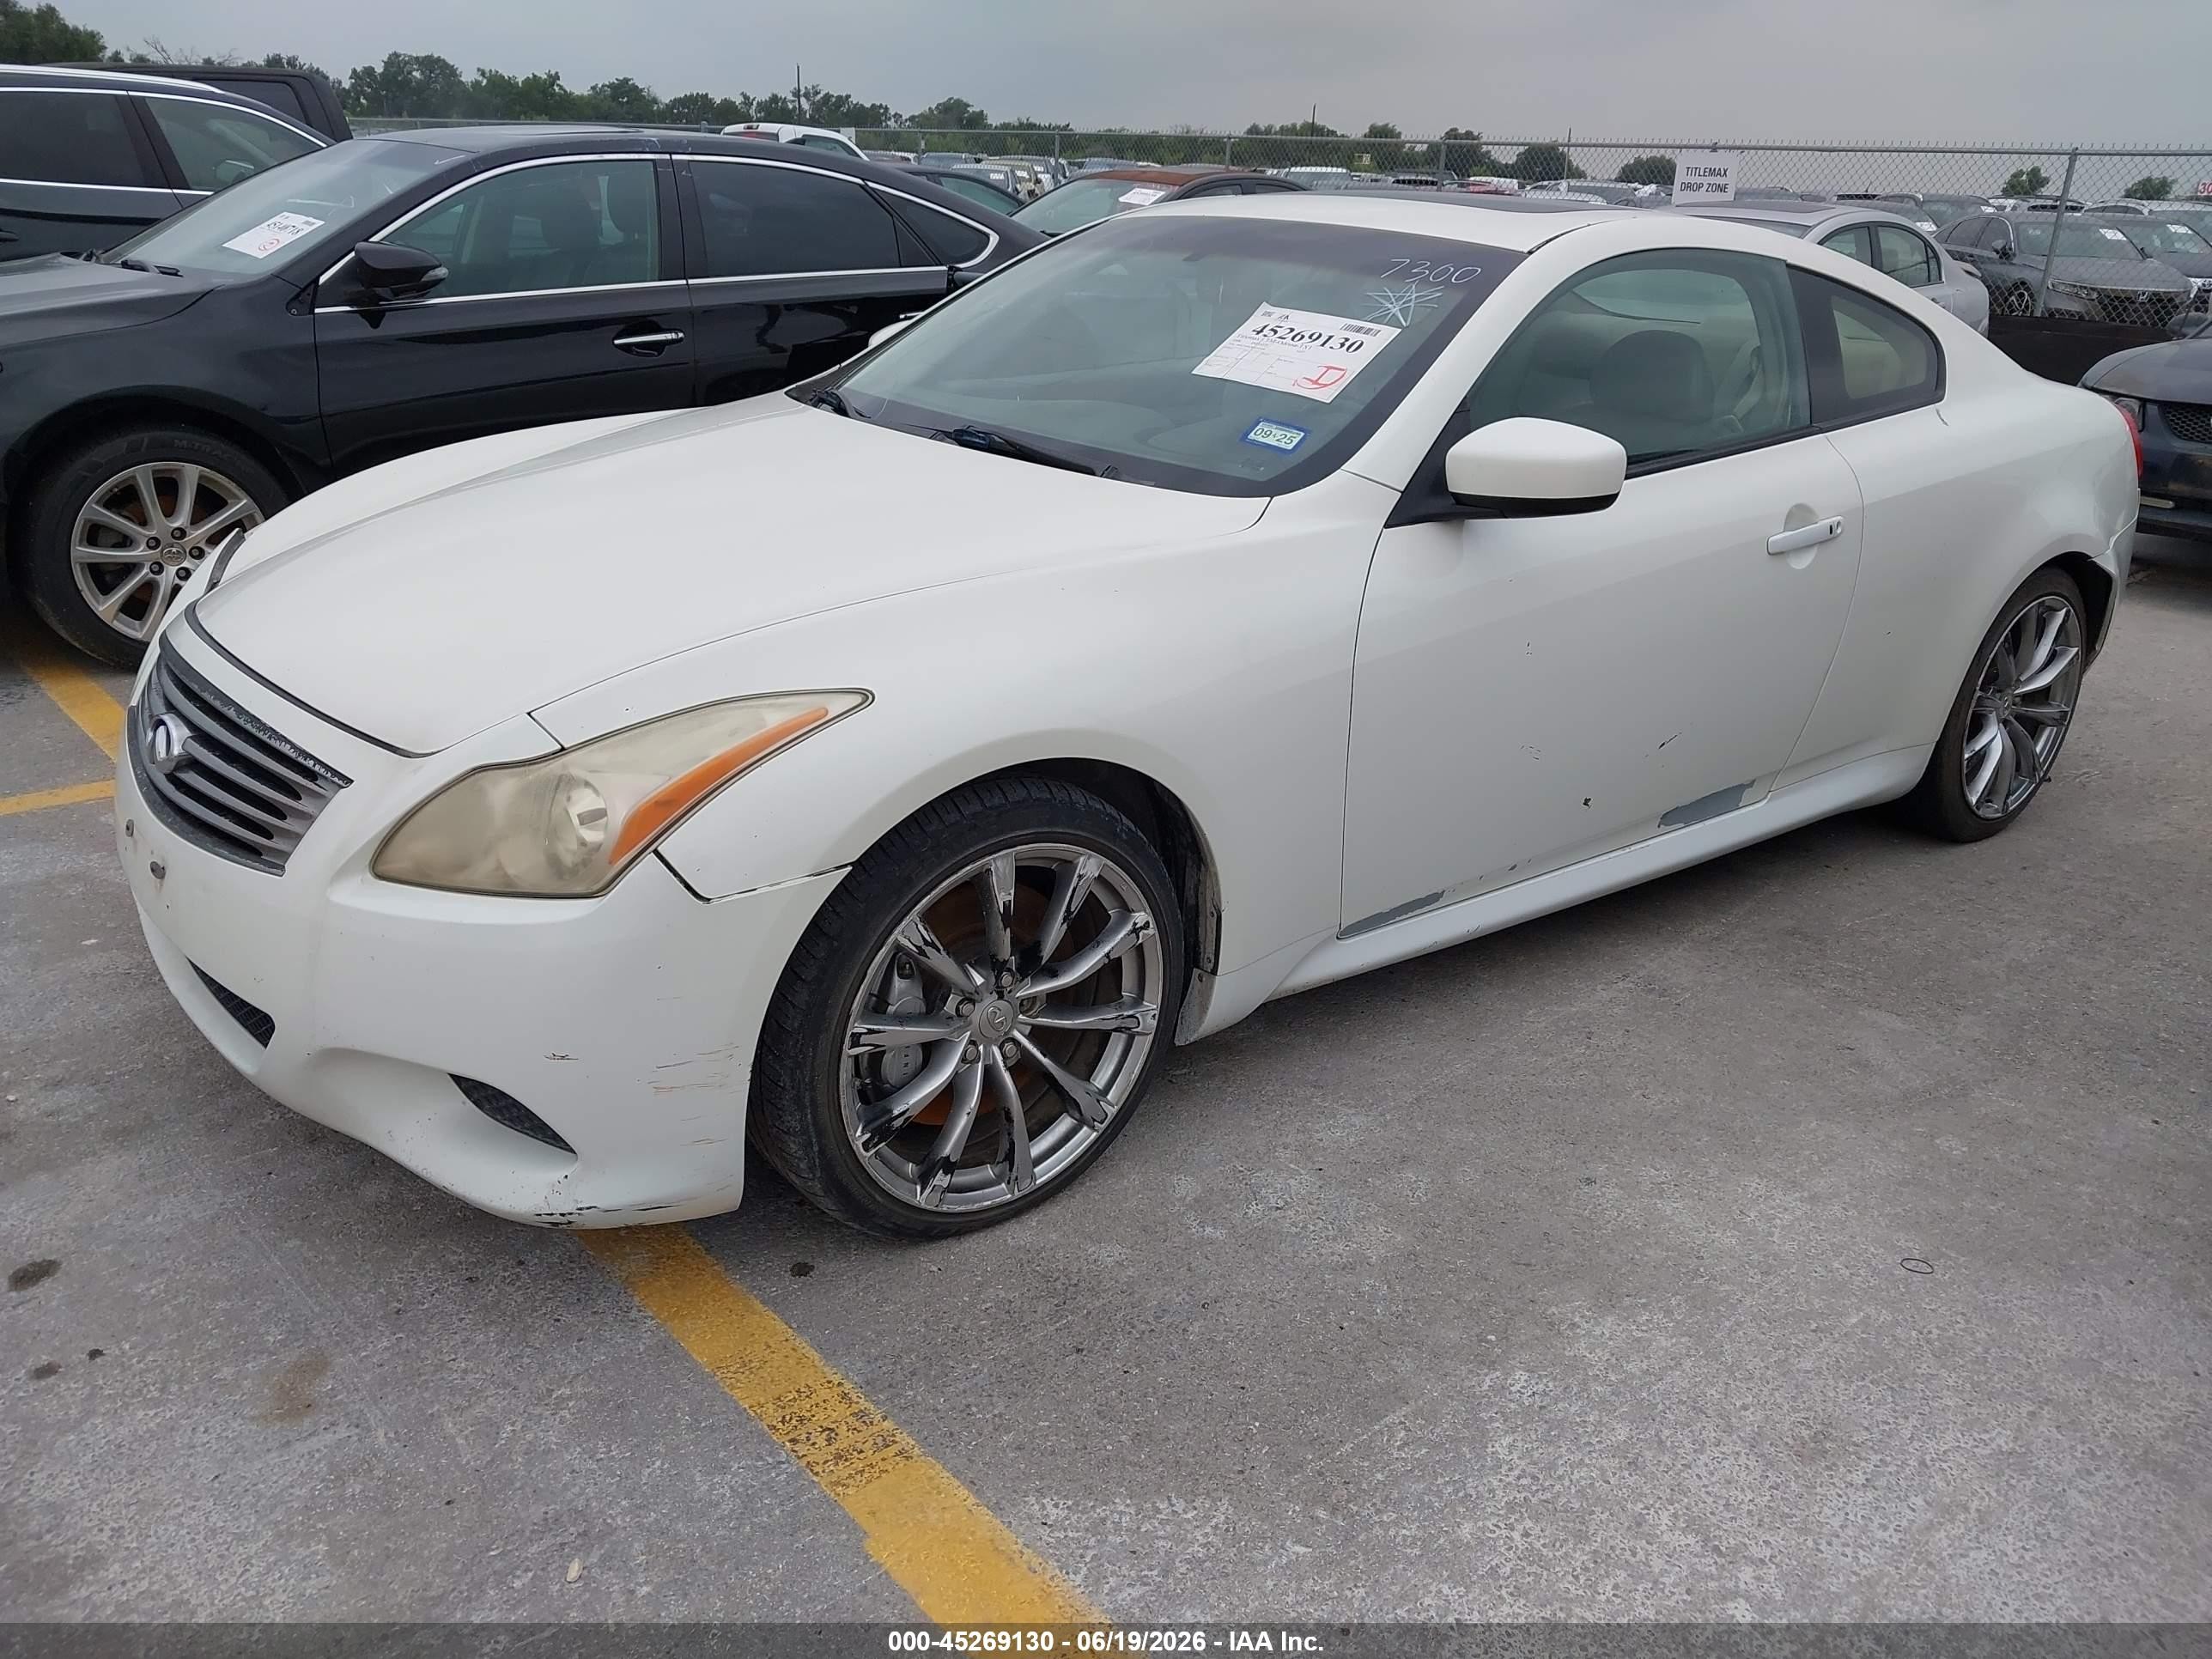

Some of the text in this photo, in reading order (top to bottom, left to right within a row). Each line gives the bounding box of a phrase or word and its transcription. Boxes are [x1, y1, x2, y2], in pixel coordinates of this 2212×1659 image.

[1685, 167, 1729, 178] TITLEMAX
[1680, 181, 1729, 193] DROP ZONE
[1380, 258, 1482, 283] 7300
[1251, 323, 1364, 354] 45269130
